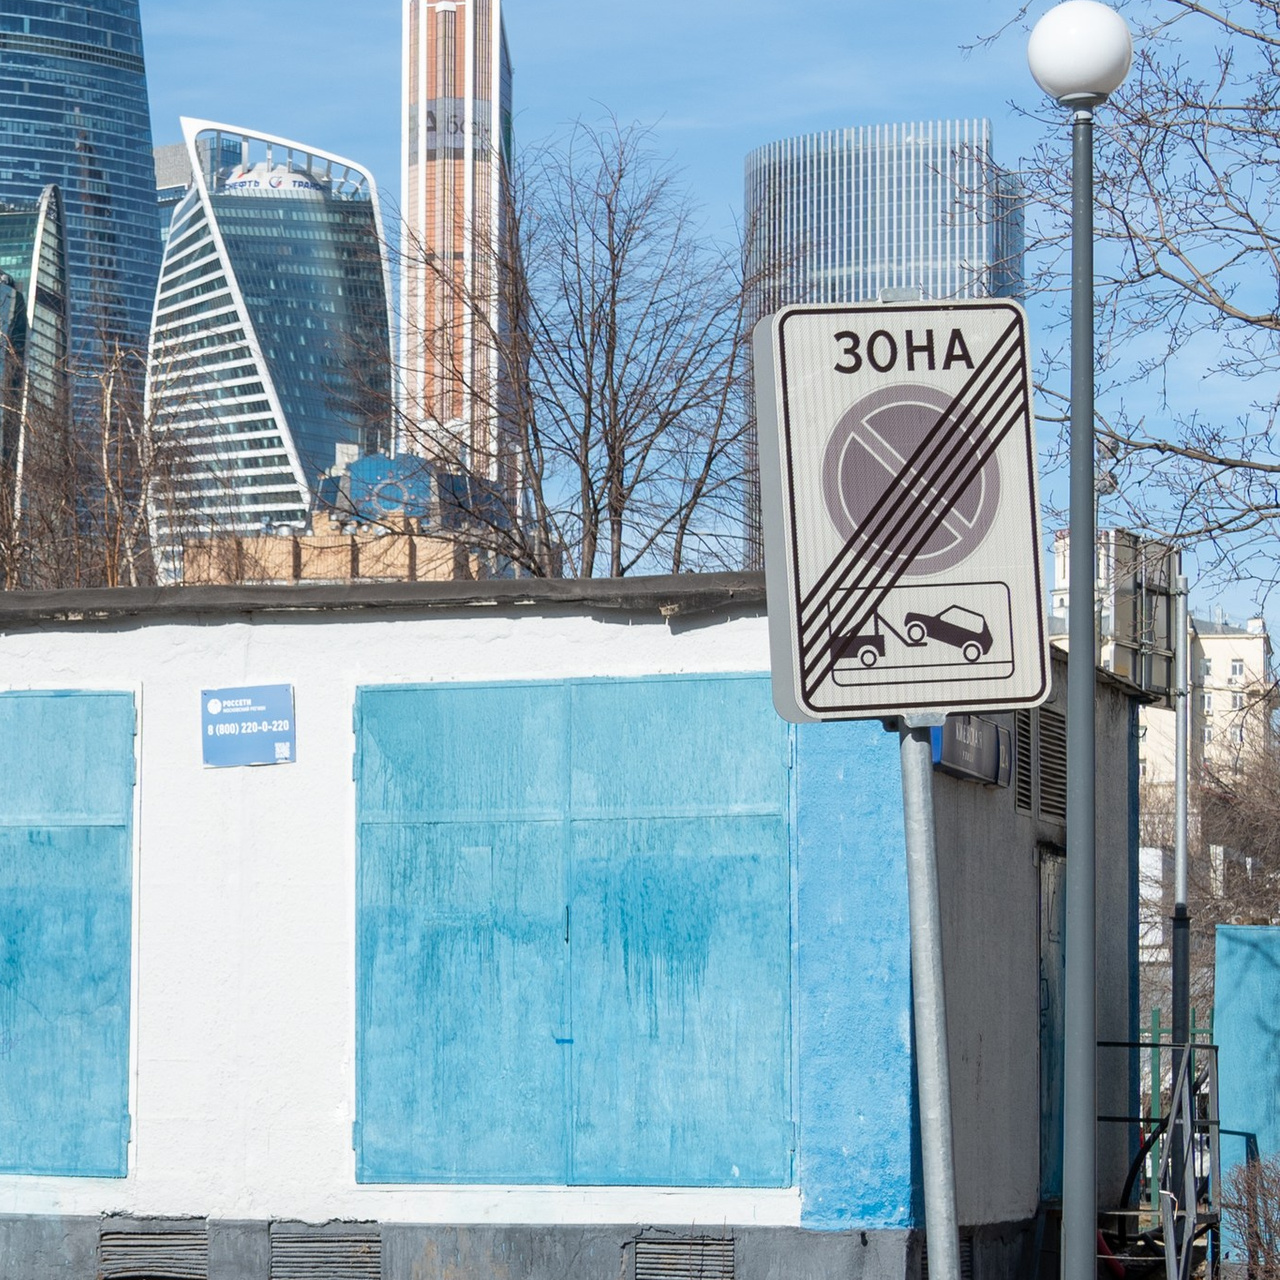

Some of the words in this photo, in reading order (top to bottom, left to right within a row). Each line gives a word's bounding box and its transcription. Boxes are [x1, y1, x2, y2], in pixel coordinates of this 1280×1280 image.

[833, 328, 975, 374] ЗОНА
[223, 699, 251, 708] РОССЕТИ
[207, 724, 214, 736] 8
[215, 723, 239, 736] (800)
[241, 720, 289, 734] 220-0-220
